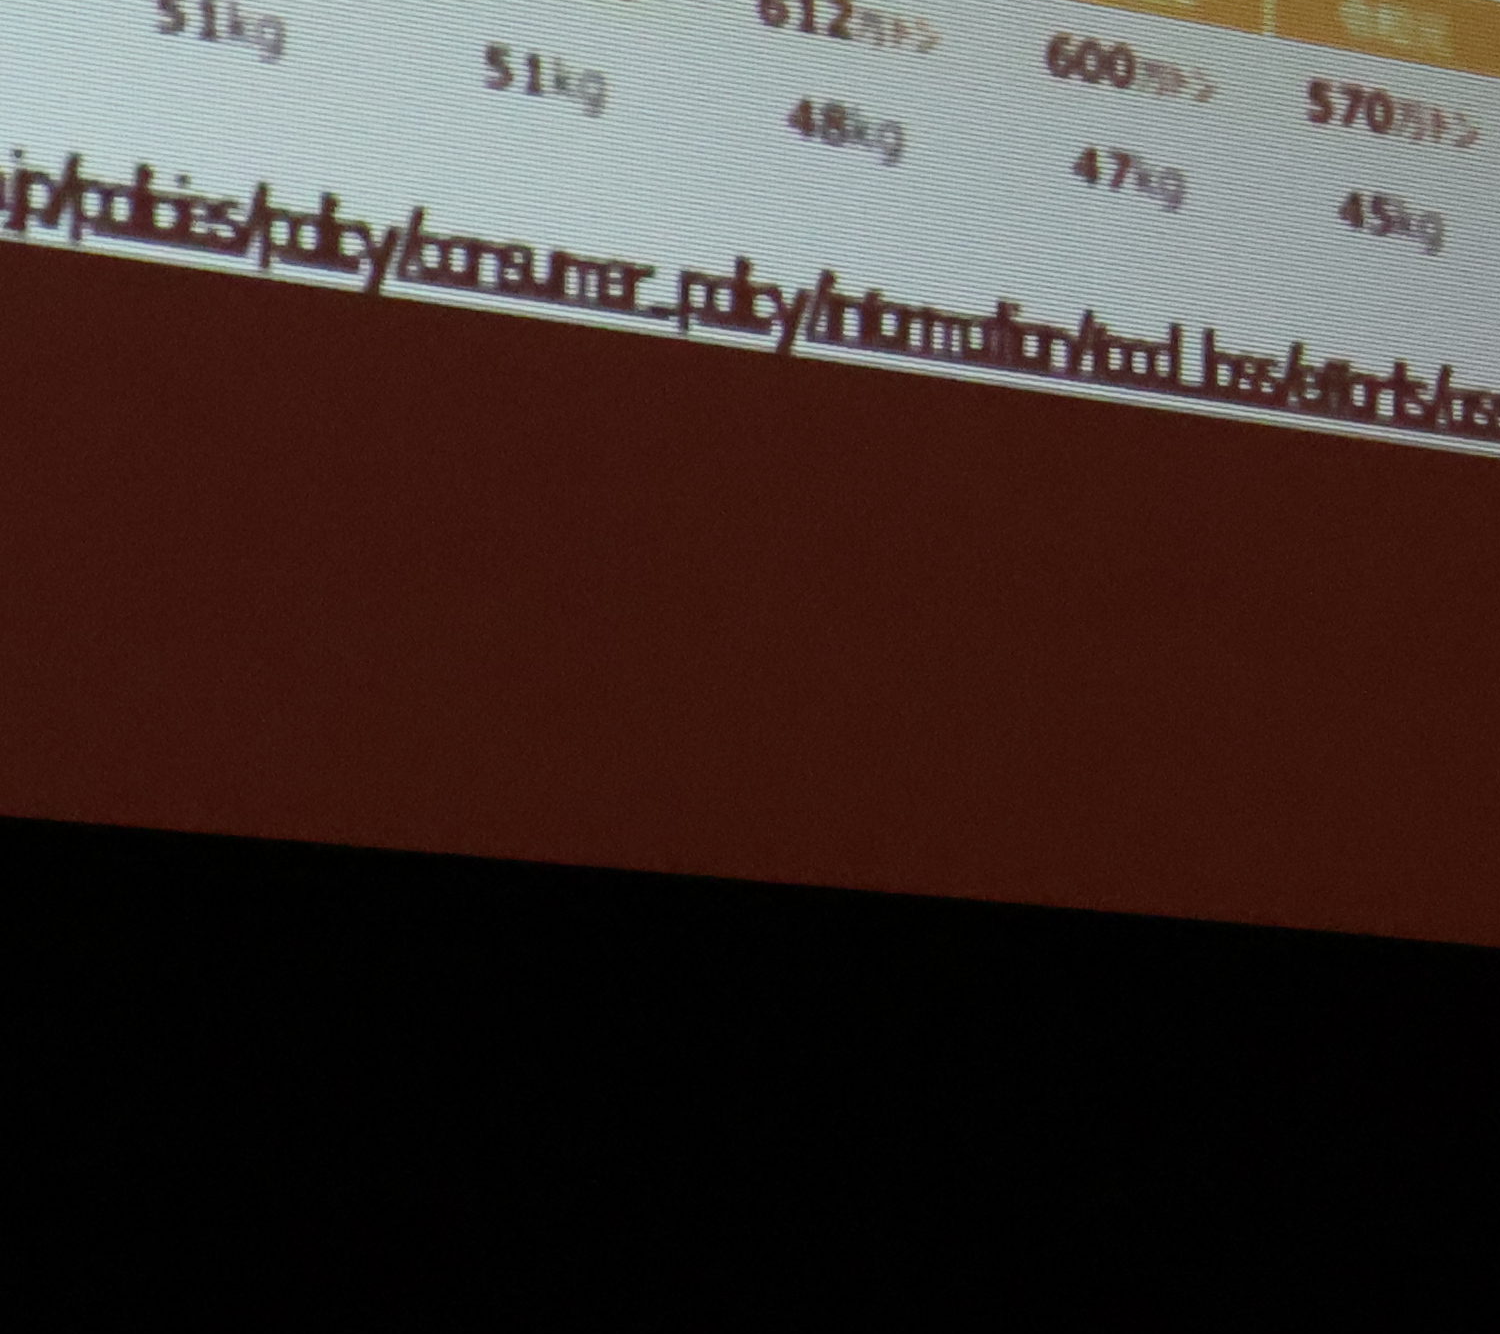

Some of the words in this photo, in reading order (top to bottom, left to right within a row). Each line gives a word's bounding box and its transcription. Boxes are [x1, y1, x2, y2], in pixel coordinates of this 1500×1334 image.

[484, 42, 609, 118] 51kg
[786, 97, 907, 166] 48kg
[1071, 146, 1189, 213] 47kg
[1337, 190, 1446, 256] 45kg
